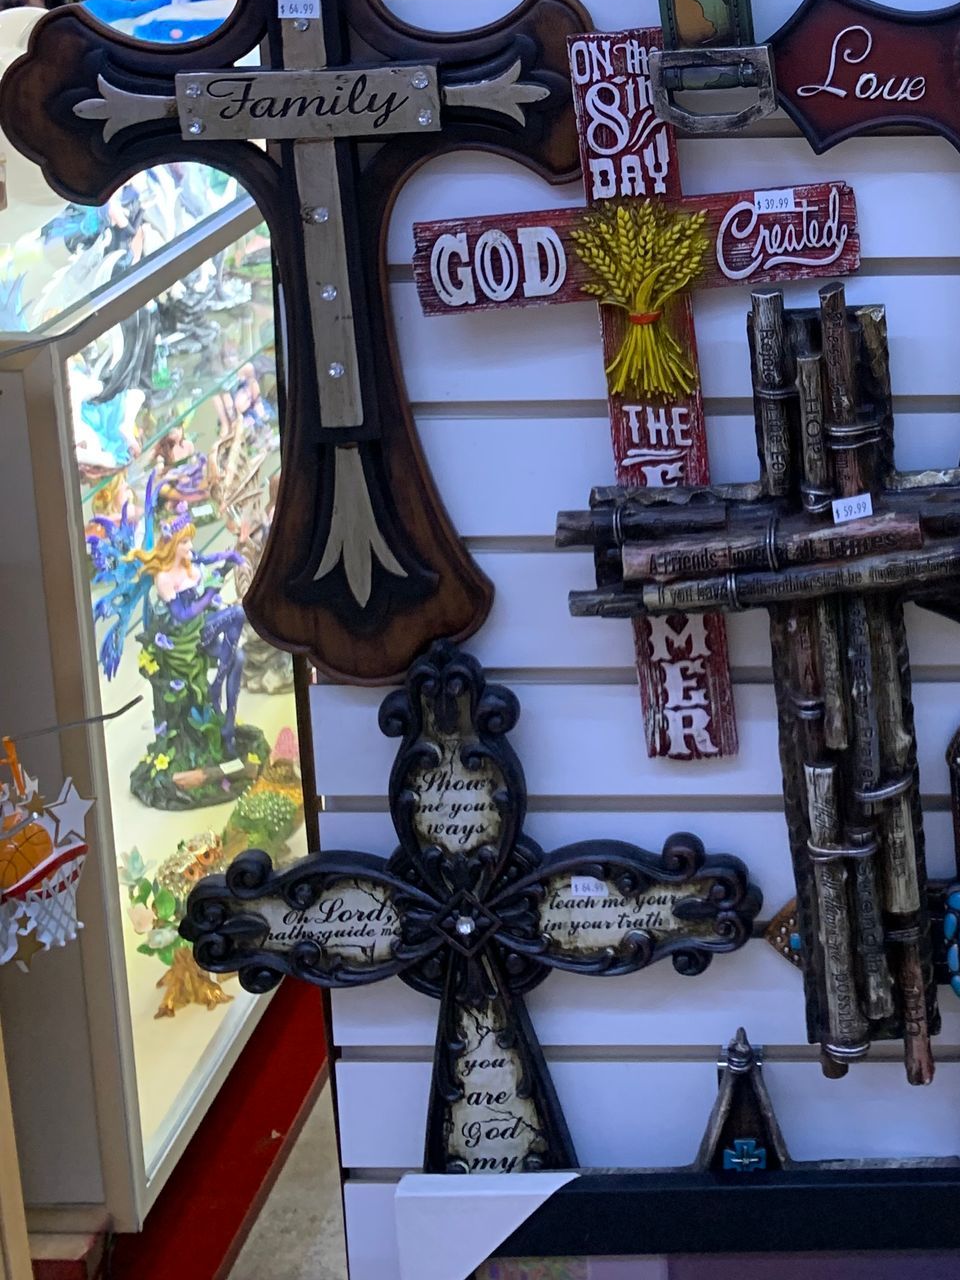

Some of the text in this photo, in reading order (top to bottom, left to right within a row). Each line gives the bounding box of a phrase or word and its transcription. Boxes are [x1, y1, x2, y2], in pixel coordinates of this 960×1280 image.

[570, 40, 614, 86] ON
[797, 25, 926, 101] Love
[206, 73, 409, 129] Family
[588, 126, 670, 201] DAY
[764, 198, 789, 210] 39.99
[716, 187, 848, 280] Created
[430, 225, 567, 307] GOD
[622, 404, 693, 448] THE
[448, 802, 496, 819] your
[427, 823, 491, 844] ways
[549, 891, 679, 914] teach me your
[282, 909, 309, 926] Oh
[543, 910, 663, 937] in your truth
[380, 927, 401, 937] me
[461, 1058, 508, 1077] you
[466, 1090, 513, 1106] are
[461, 1116, 526, 1149] God
[471, 1156, 520, 1174] my
